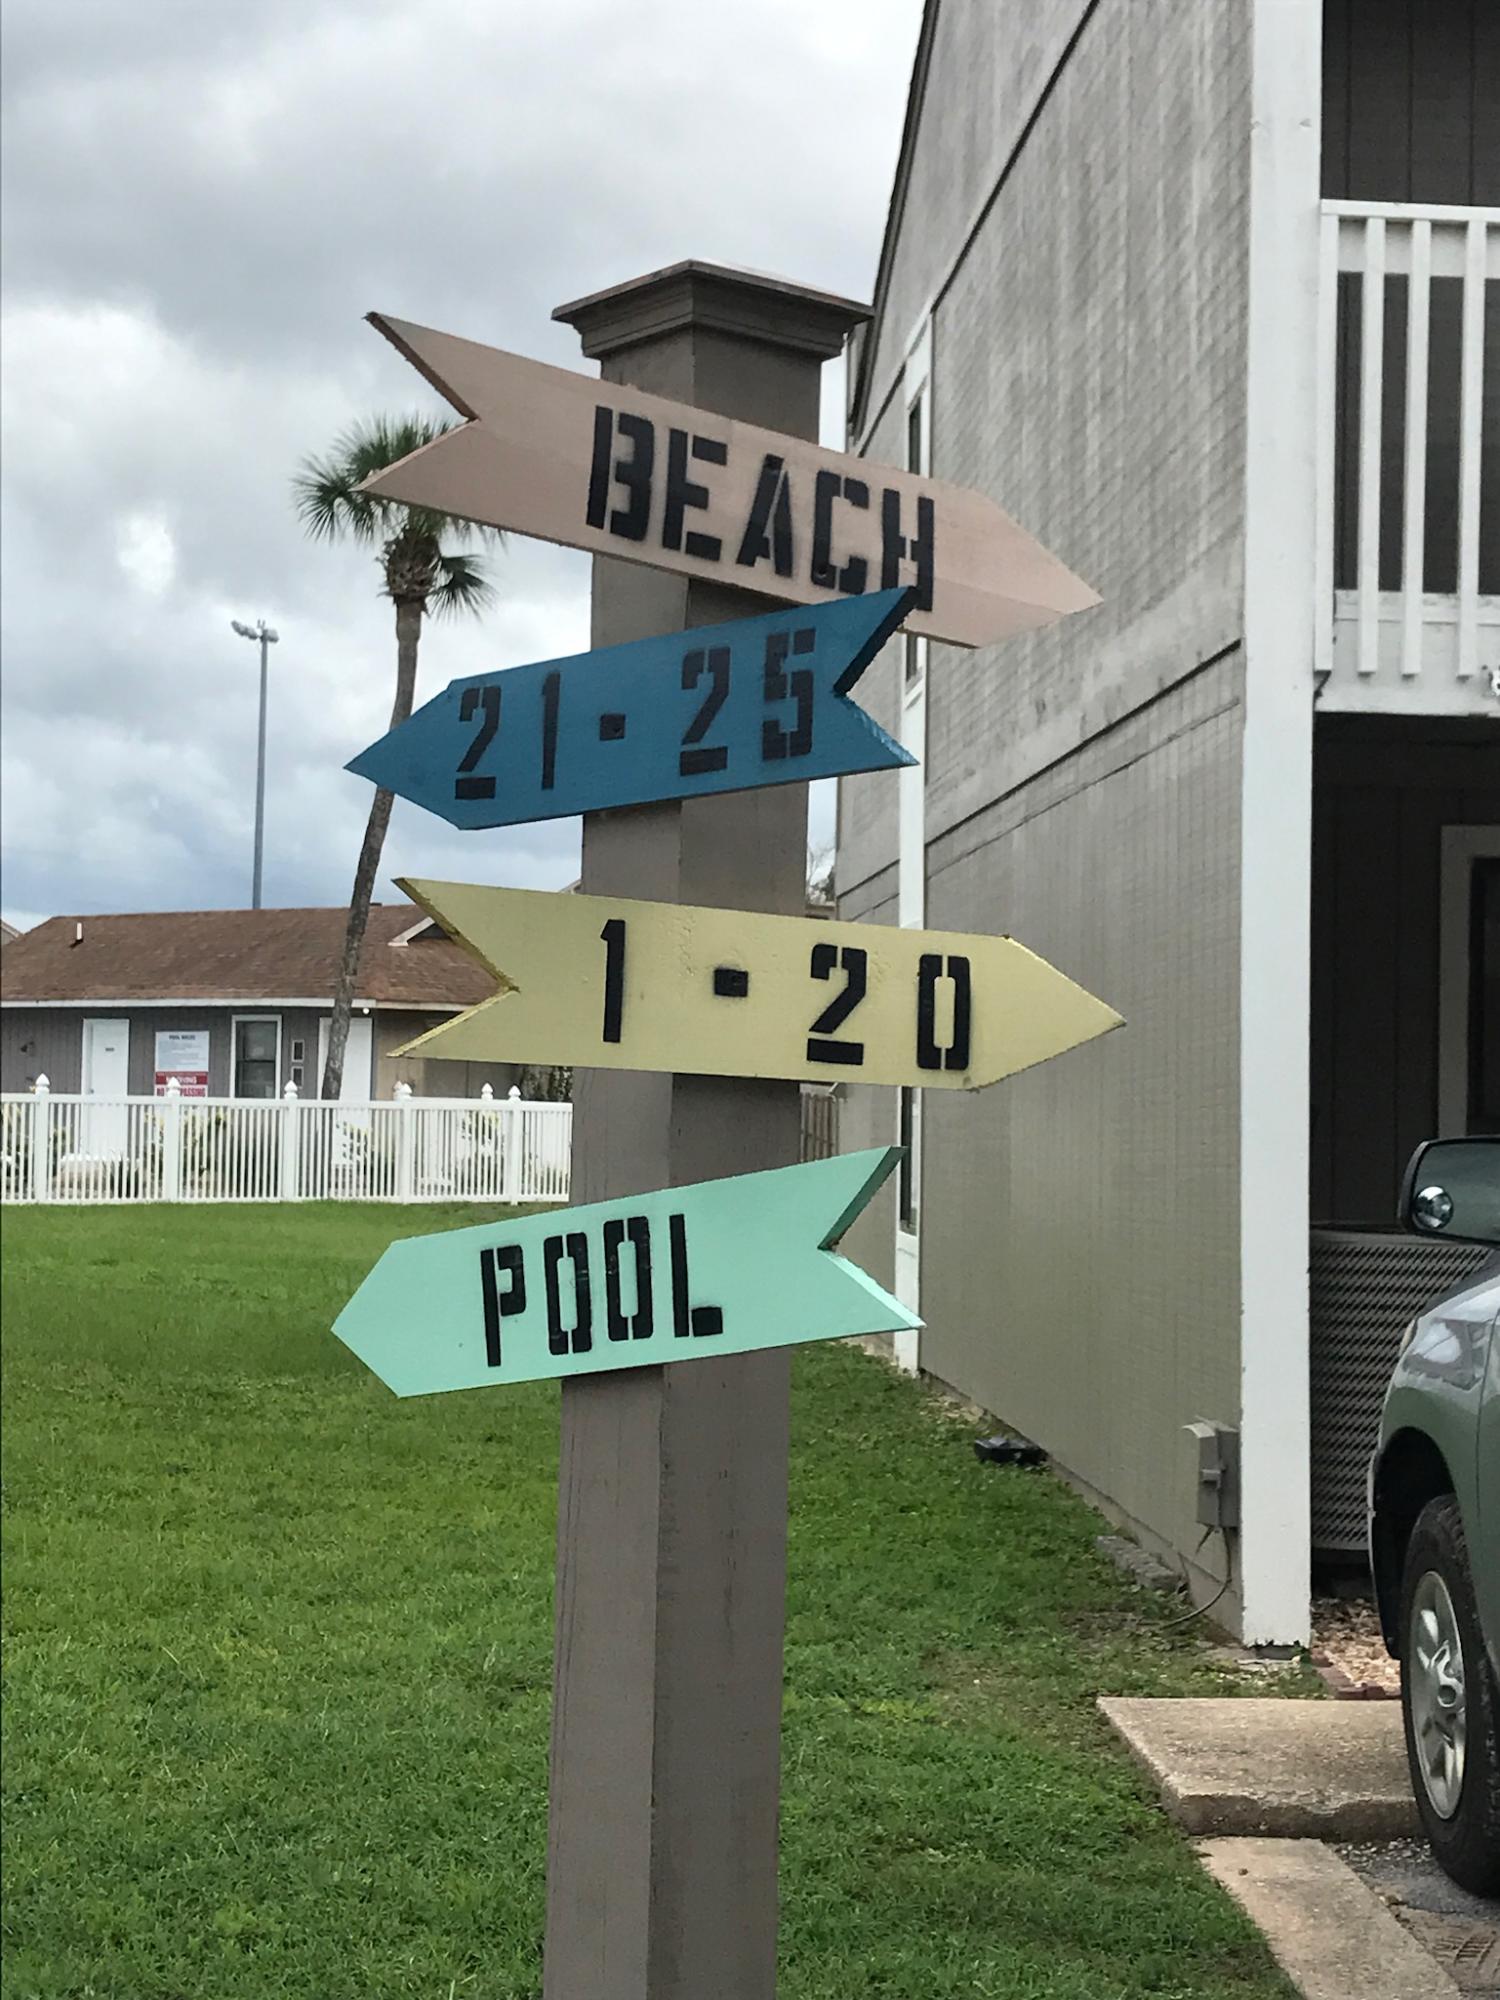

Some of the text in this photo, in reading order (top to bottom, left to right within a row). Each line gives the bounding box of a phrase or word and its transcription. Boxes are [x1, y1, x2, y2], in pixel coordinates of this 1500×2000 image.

[586, 405, 935, 611] BEACH
[600, 919, 626, 1043] 1
[806, 943, 971, 1070] 20
[480, 1213, 723, 1367] POOL
